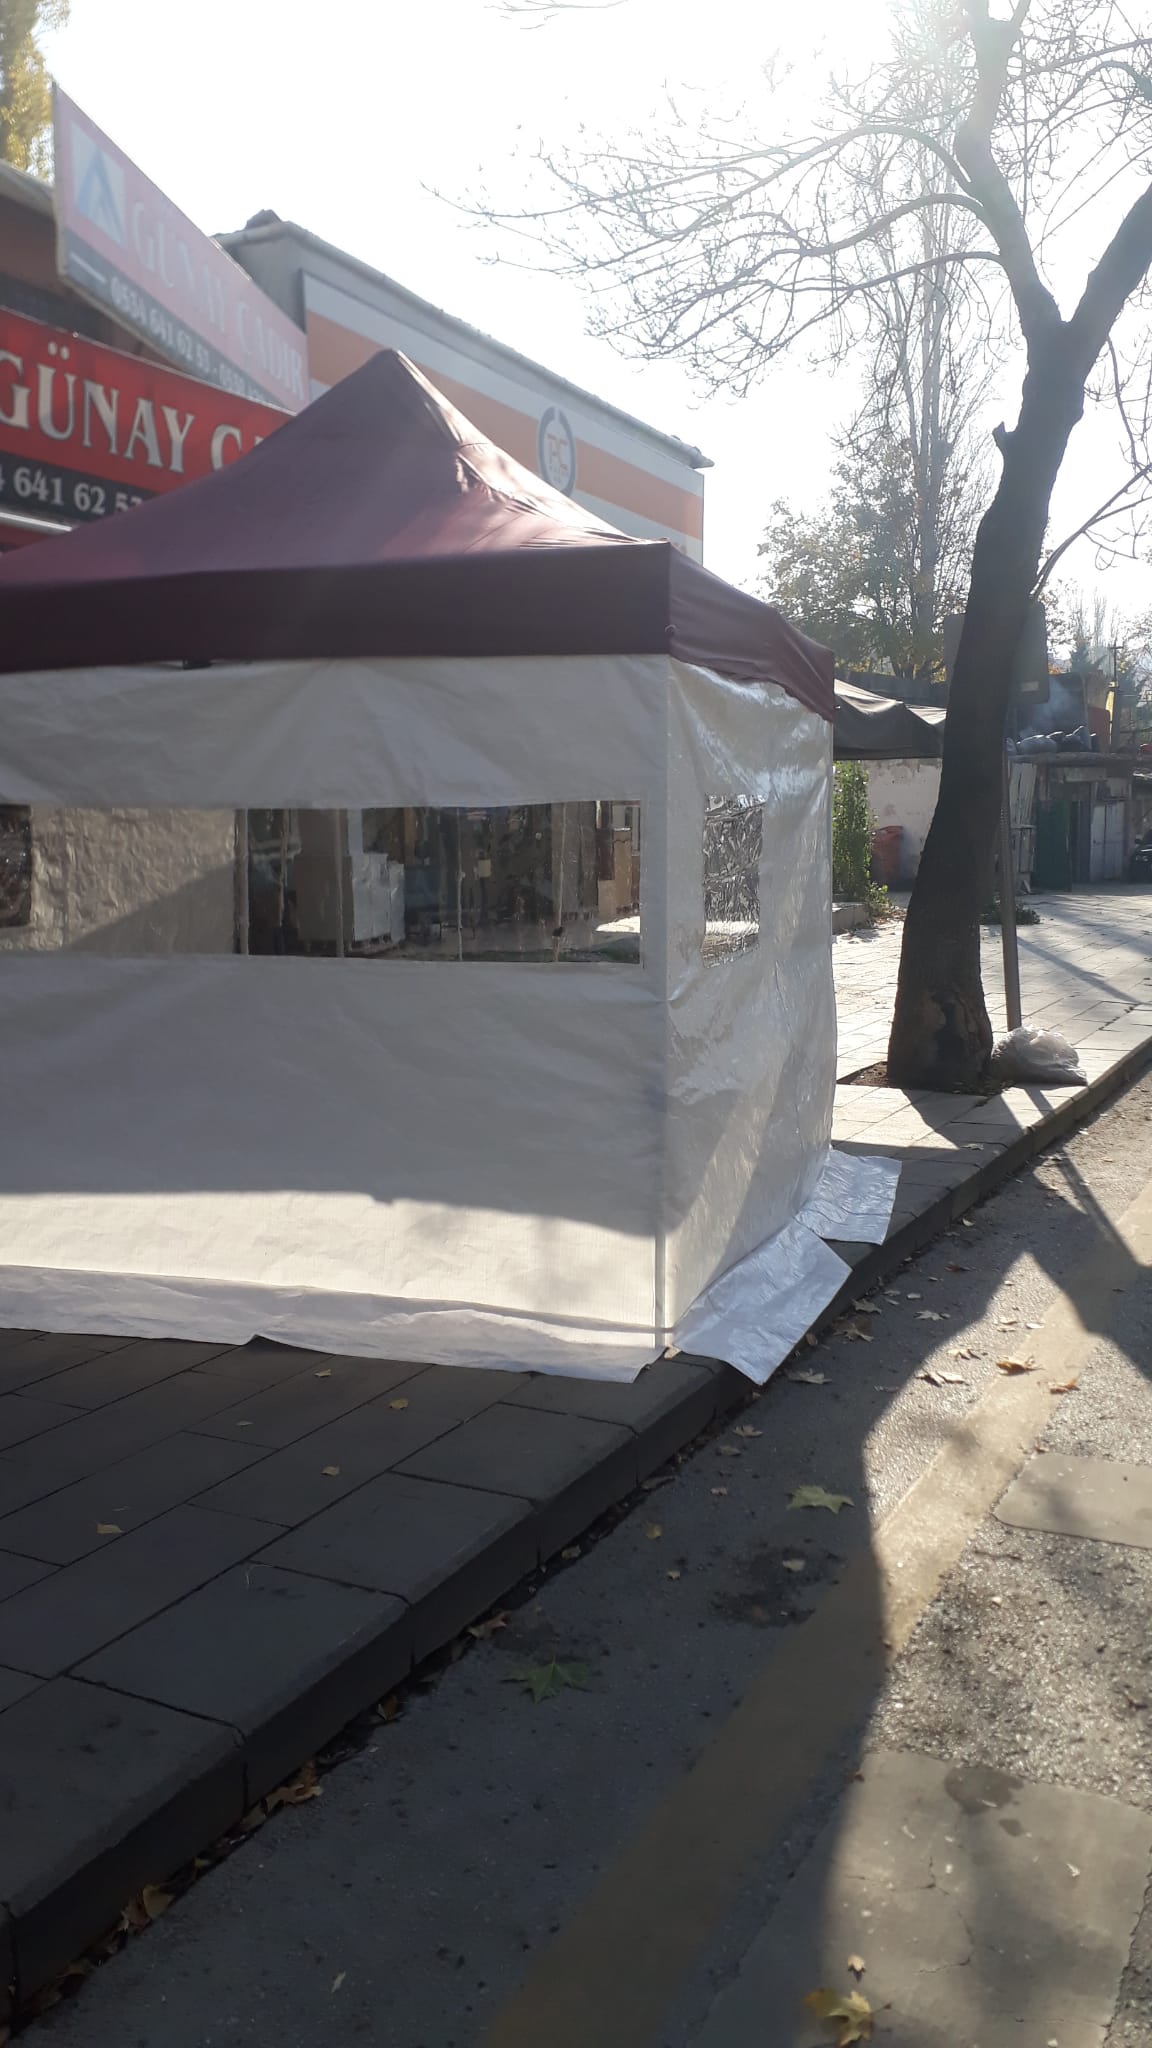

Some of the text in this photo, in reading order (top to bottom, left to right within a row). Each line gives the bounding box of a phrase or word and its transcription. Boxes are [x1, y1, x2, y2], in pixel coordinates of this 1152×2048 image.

[0, 342, 194, 473] GÜNAY
[13, 467, 64, 505] 641
[73, 482, 106, 515] 62
